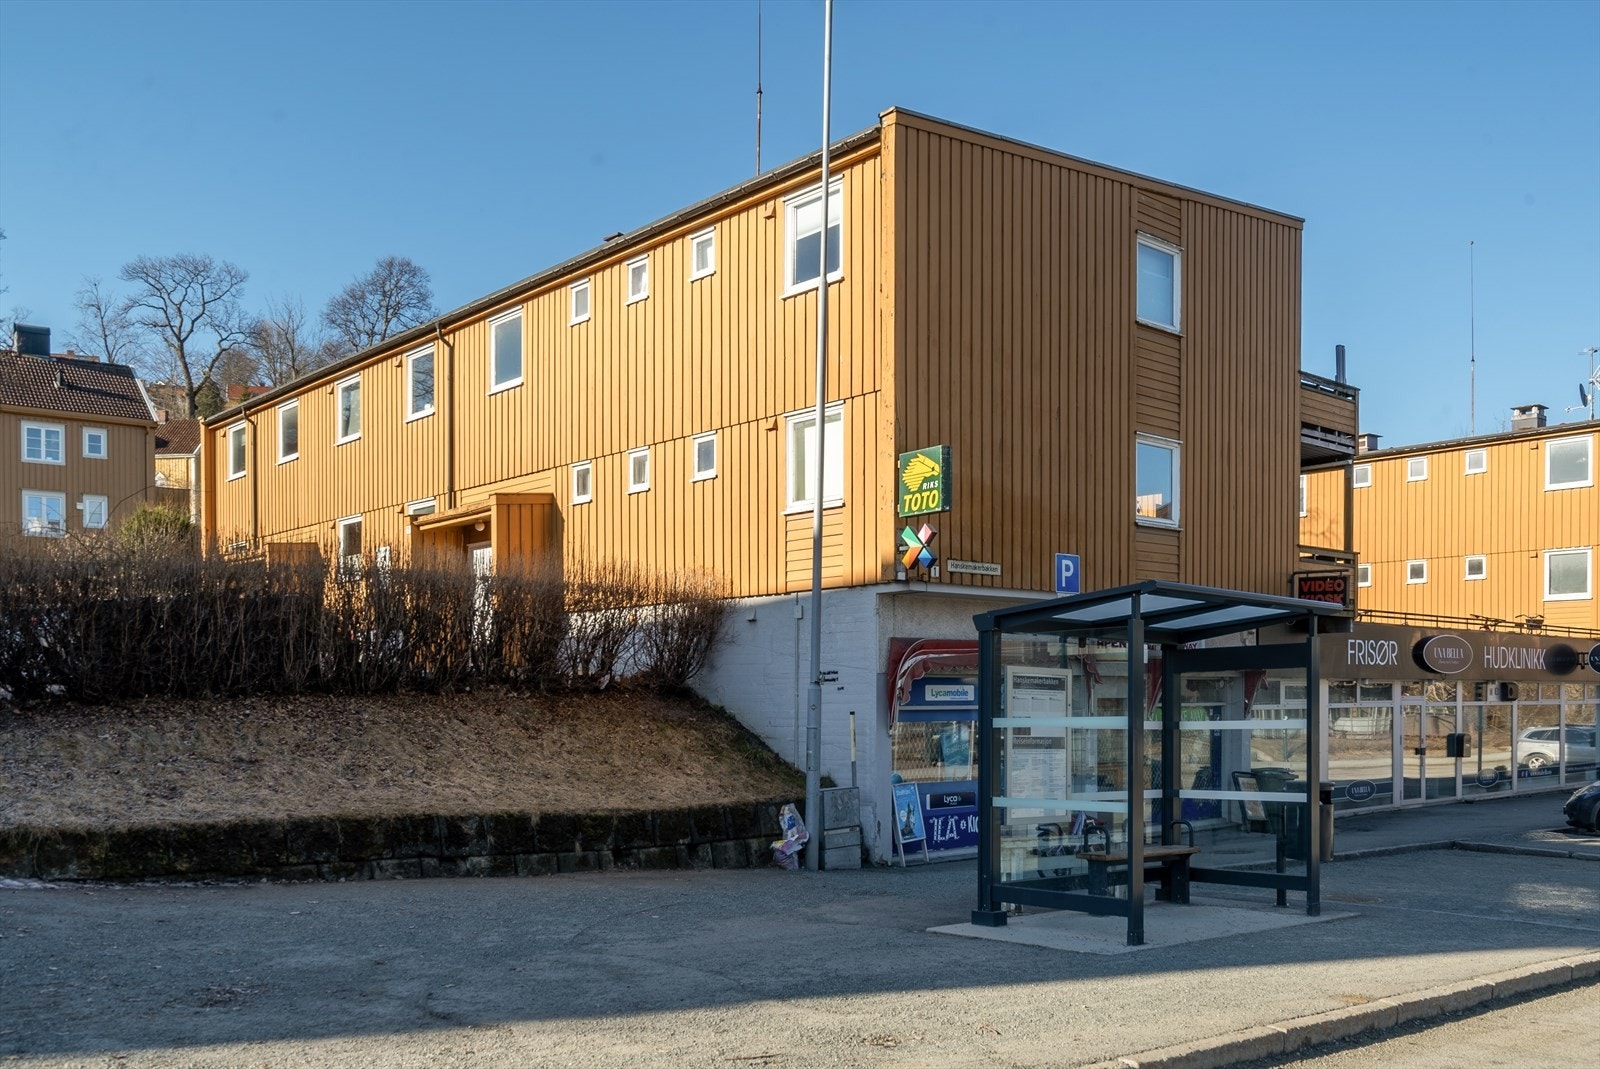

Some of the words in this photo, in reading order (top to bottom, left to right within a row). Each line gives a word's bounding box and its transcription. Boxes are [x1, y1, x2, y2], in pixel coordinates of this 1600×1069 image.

[922, 480, 938, 490] RIKS
[903, 491, 938, 513] TOTO
[1062, 559, 1074, 587] P
[1300, 579, 1344, 592] VIDEO
[1347, 639, 1398, 666] FRISØR
[1484, 646, 1546, 670] HUDKLINIKK
[931, 688, 968, 698] Lycamobile
[943, 795, 958, 804] Lyca
